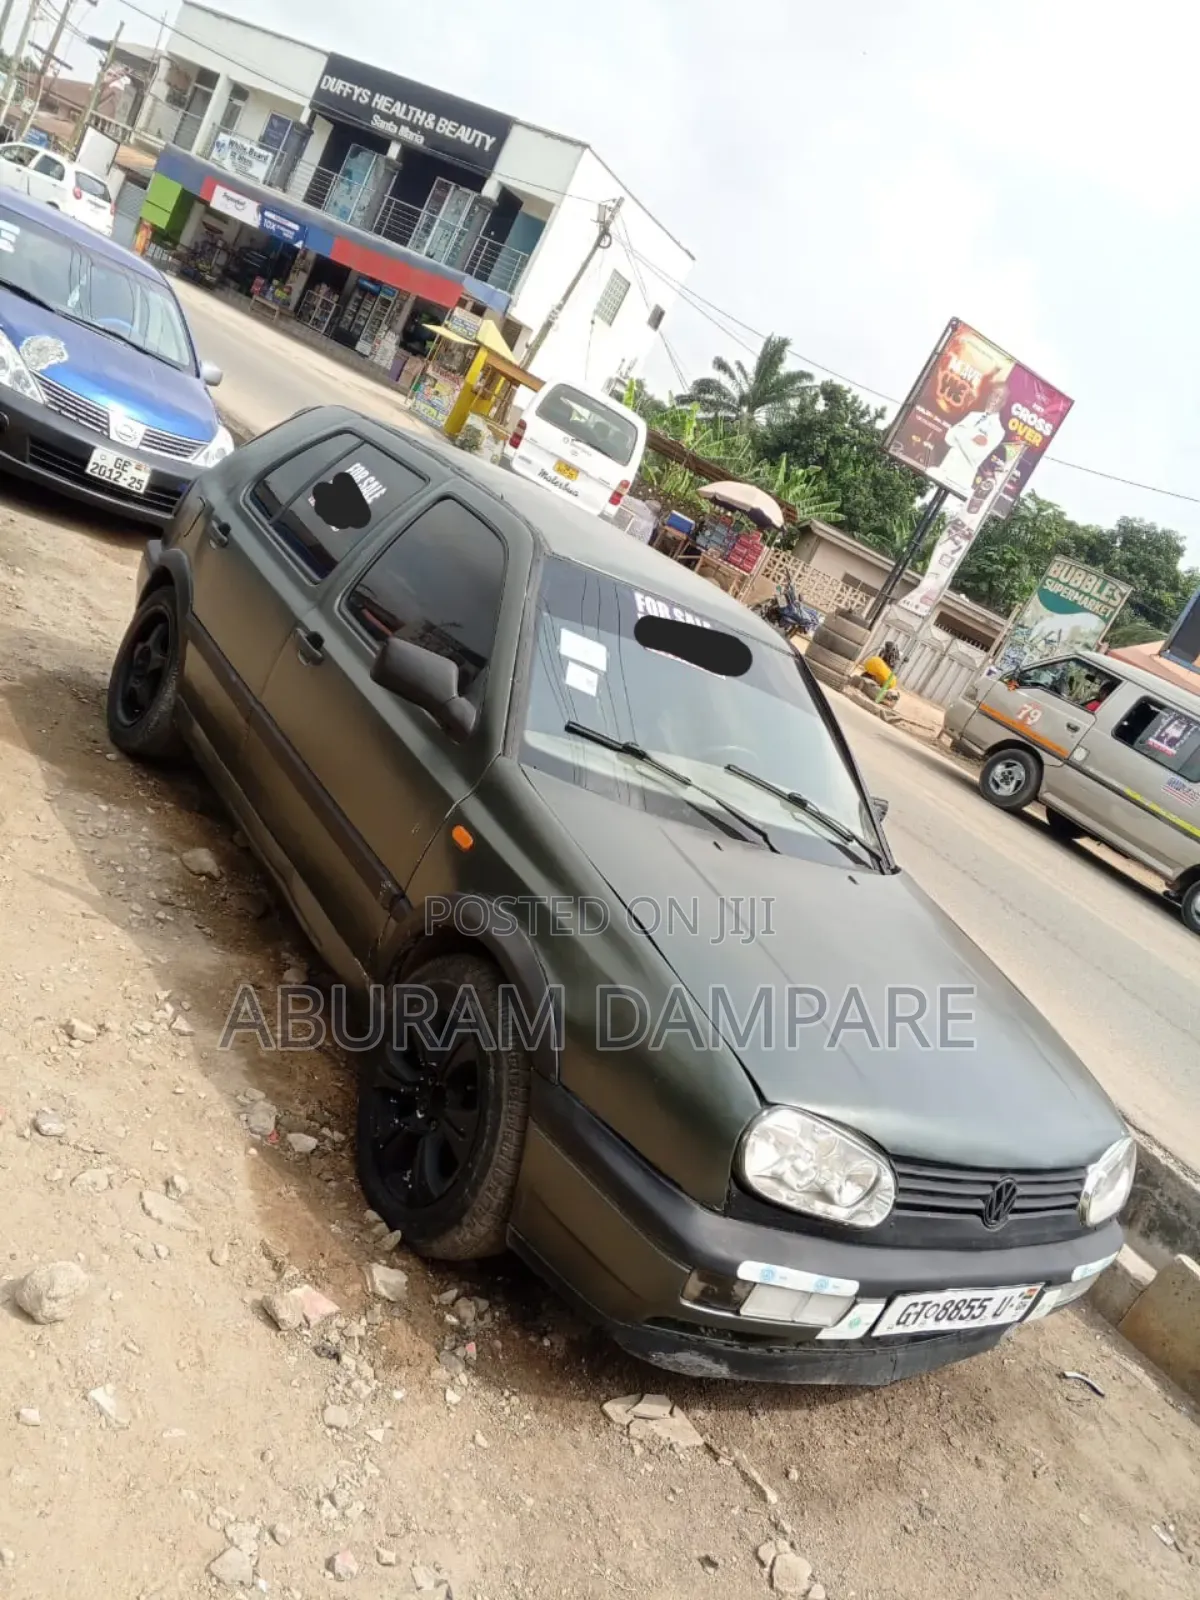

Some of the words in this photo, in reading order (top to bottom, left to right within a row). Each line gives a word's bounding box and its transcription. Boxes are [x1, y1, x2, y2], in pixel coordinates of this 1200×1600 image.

[320, 75, 371, 104] DUFFYS
[435, 117, 497, 151] BEAUTY
[370, 113, 398, 134] Santa
[398, 127, 425, 144] Maria
[1008, 418, 1043, 447] OVER
[1010, 403, 1053, 436] CROSS
[89, 461, 145, 491] 2012-25
[113, 457, 132, 473] GE
[344, 462, 370, 484] FOR
[1043, 578, 1116, 619] SUPERMARKET
[1047, 561, 1122, 607] BUBBLES
[633, 591, 671, 620] FOR
[1017, 703, 1042, 725] 79
[935, 1297, 994, 1322] 8855
